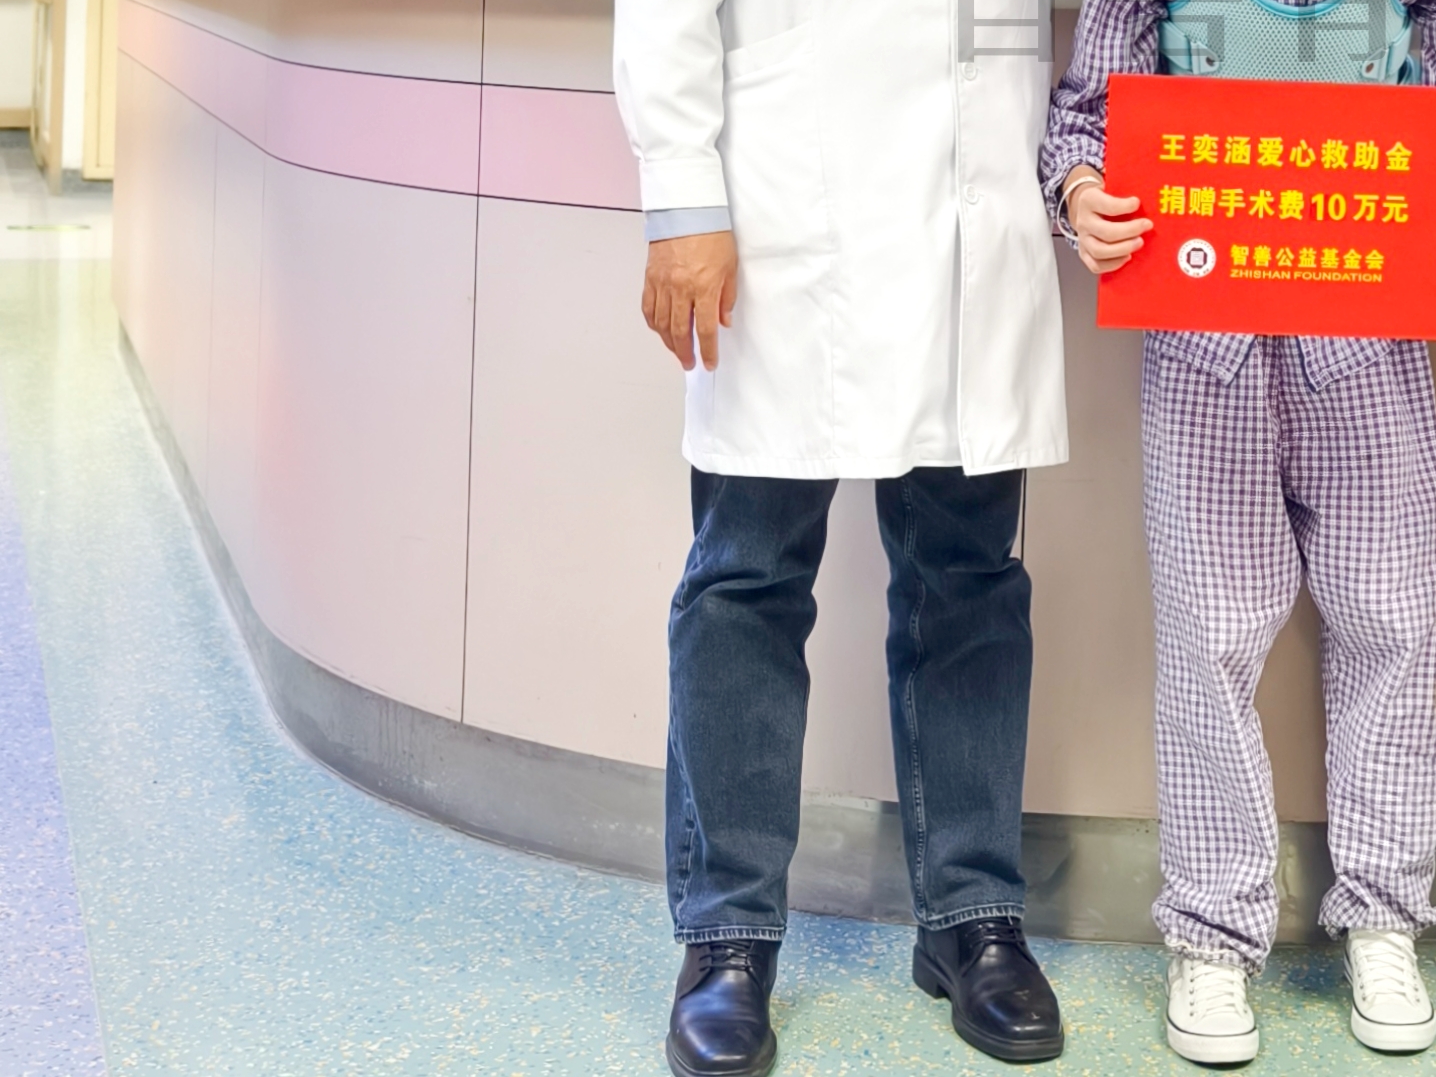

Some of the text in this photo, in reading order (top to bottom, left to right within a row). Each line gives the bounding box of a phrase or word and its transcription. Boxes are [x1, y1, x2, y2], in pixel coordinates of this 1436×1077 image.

[1159, 134, 1412, 172] 王奕涵爱心救助金
[1159, 185, 1409, 223] 捐赠手术费10万元
[1230, 244, 1385, 270] 智善公益基金会
[1230, 268, 1382, 283] ZHISHAN FOUNDATION
